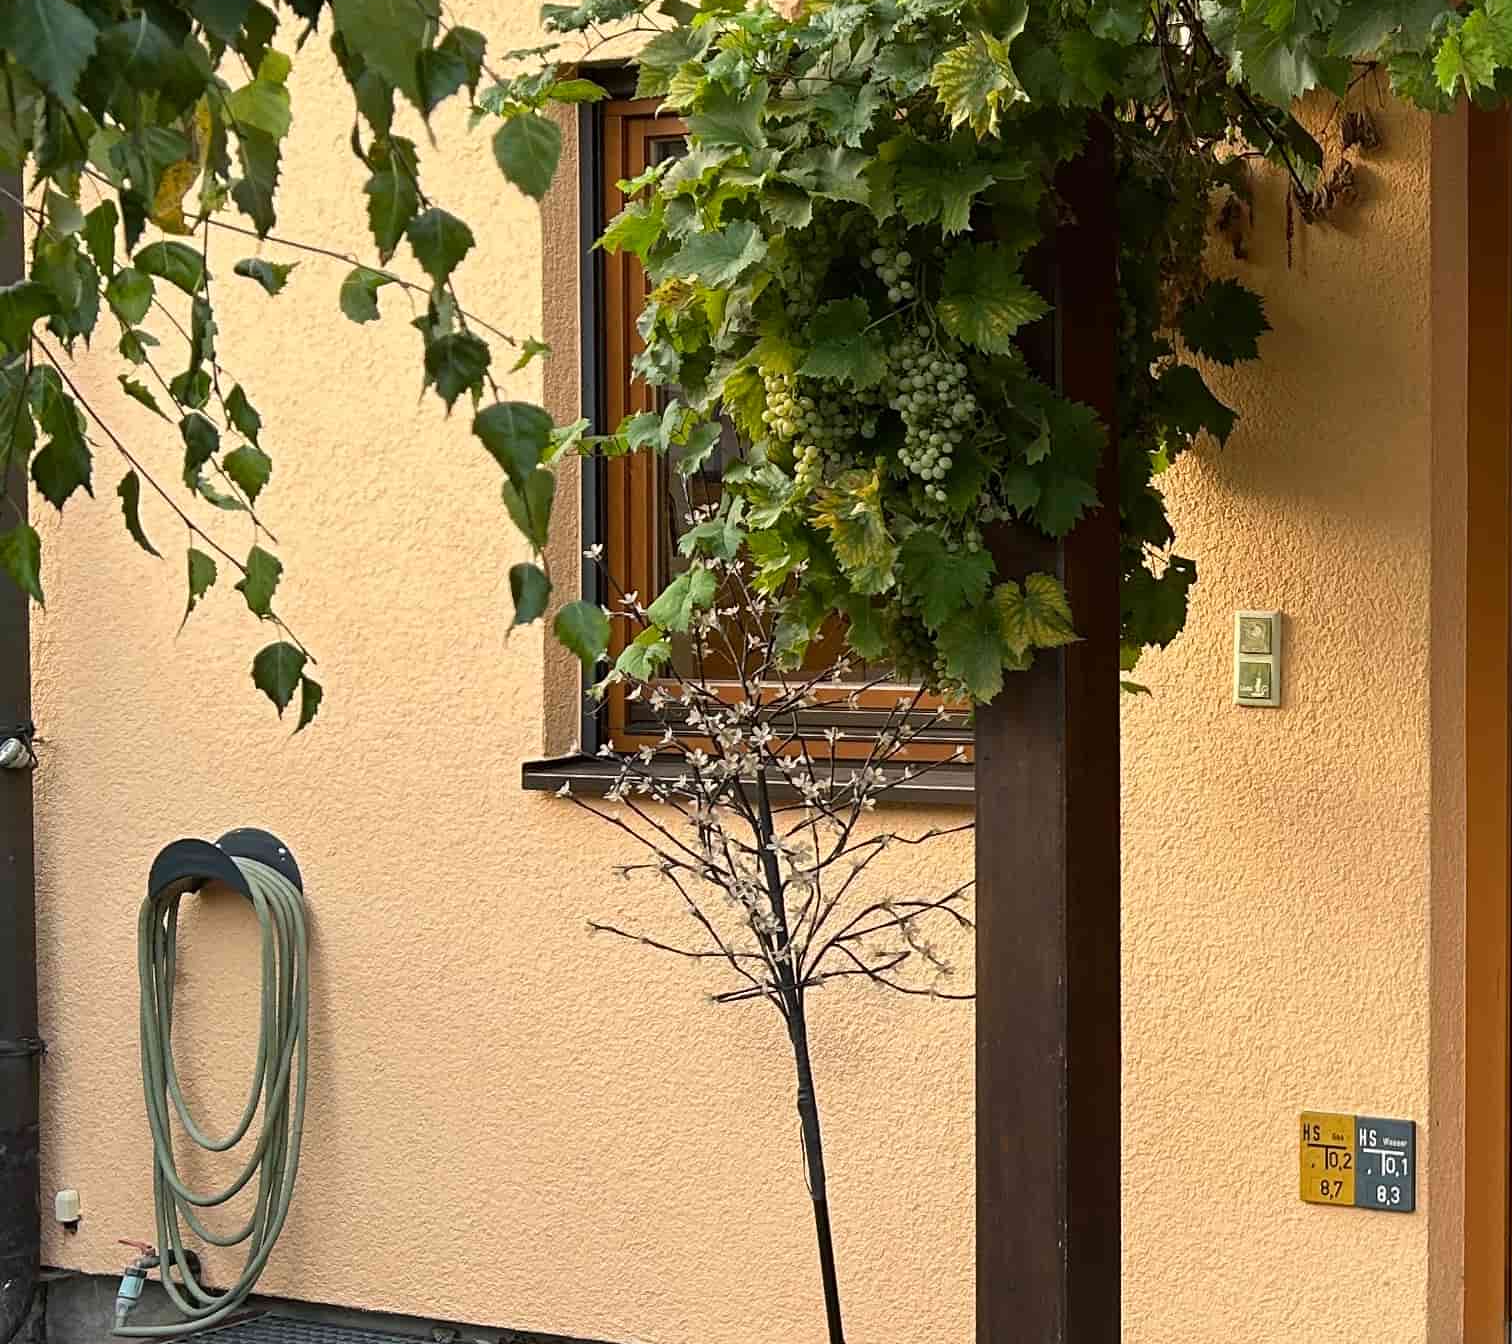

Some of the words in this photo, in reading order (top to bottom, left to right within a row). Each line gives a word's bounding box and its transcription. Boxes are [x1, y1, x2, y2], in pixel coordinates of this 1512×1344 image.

[1303, 1123, 1321, 1142] HS
[1359, 1128, 1377, 1147] HS
[1320, 1179, 1343, 1200] 8,7
[1376, 1184, 1400, 1206] 8,3
